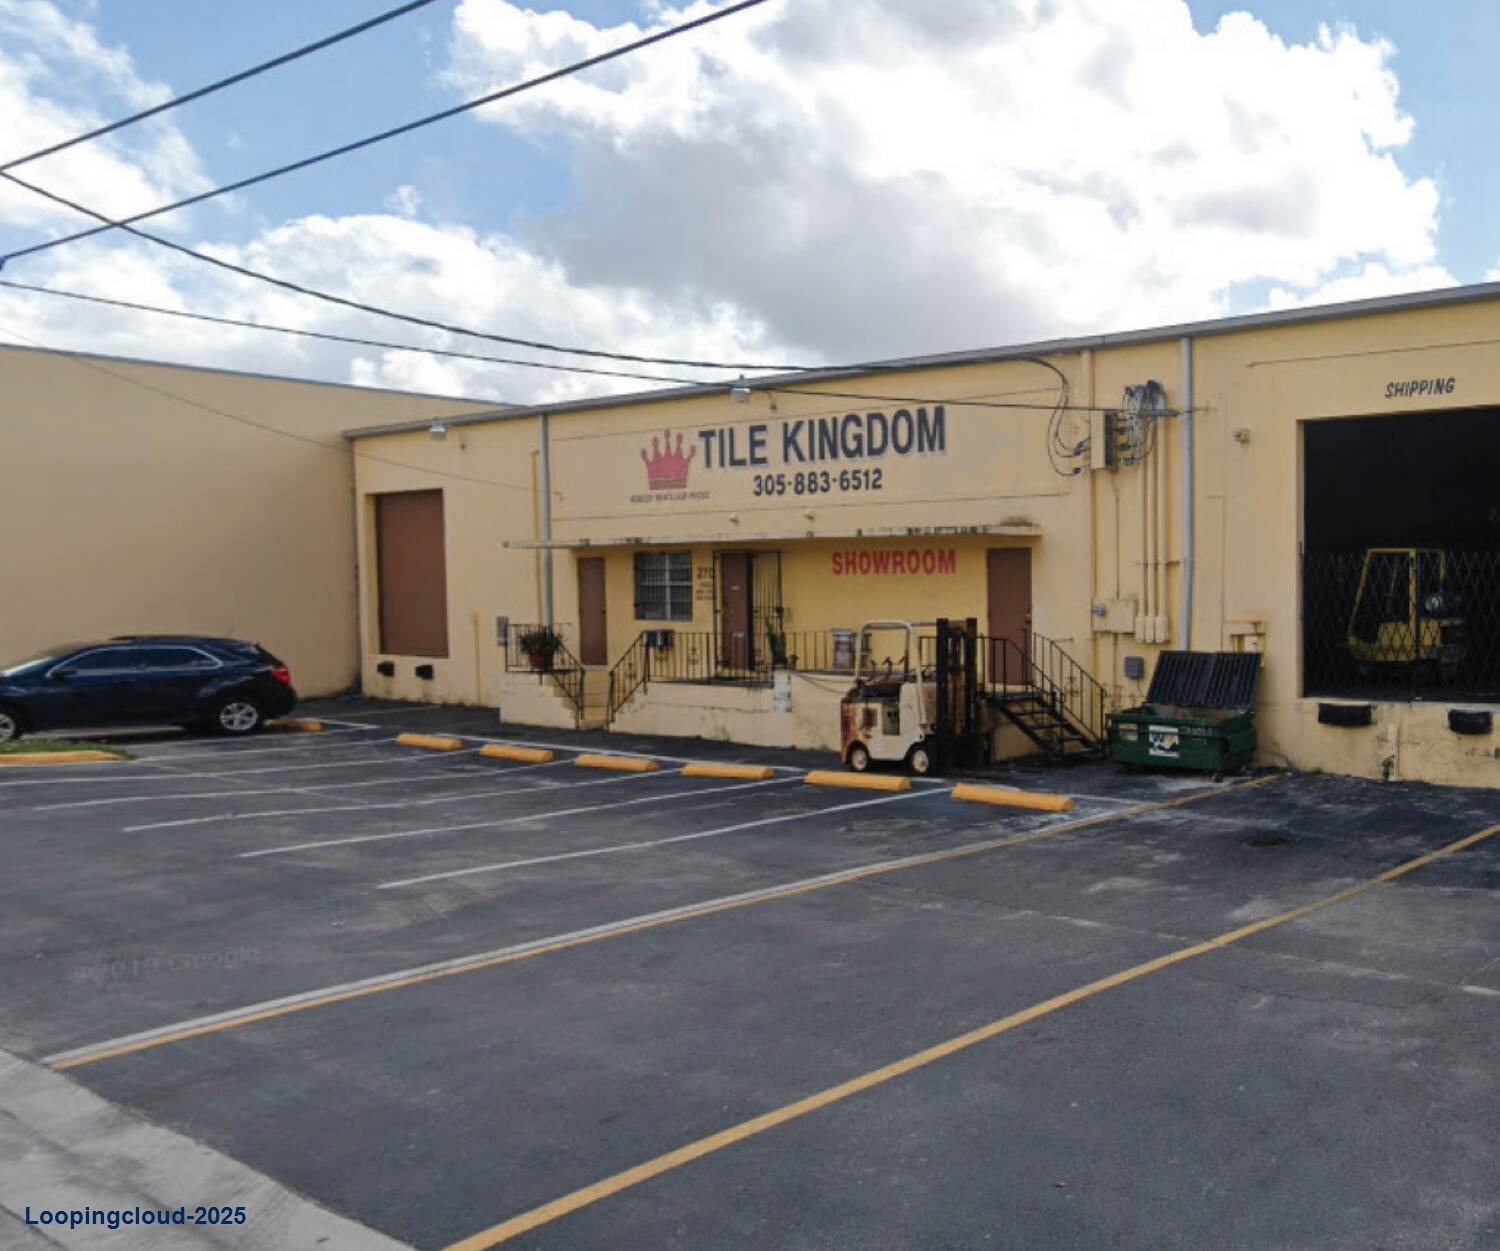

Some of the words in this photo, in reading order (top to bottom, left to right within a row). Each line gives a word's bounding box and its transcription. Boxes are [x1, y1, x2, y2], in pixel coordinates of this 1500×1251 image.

[1384, 376, 1456, 399] SHIPPING
[698, 424, 768, 469] TILE
[782, 405, 946, 463] KINGDOM
[753, 468, 883, 497] 305-883-6512
[831, 549, 957, 576] SHOWROOM
